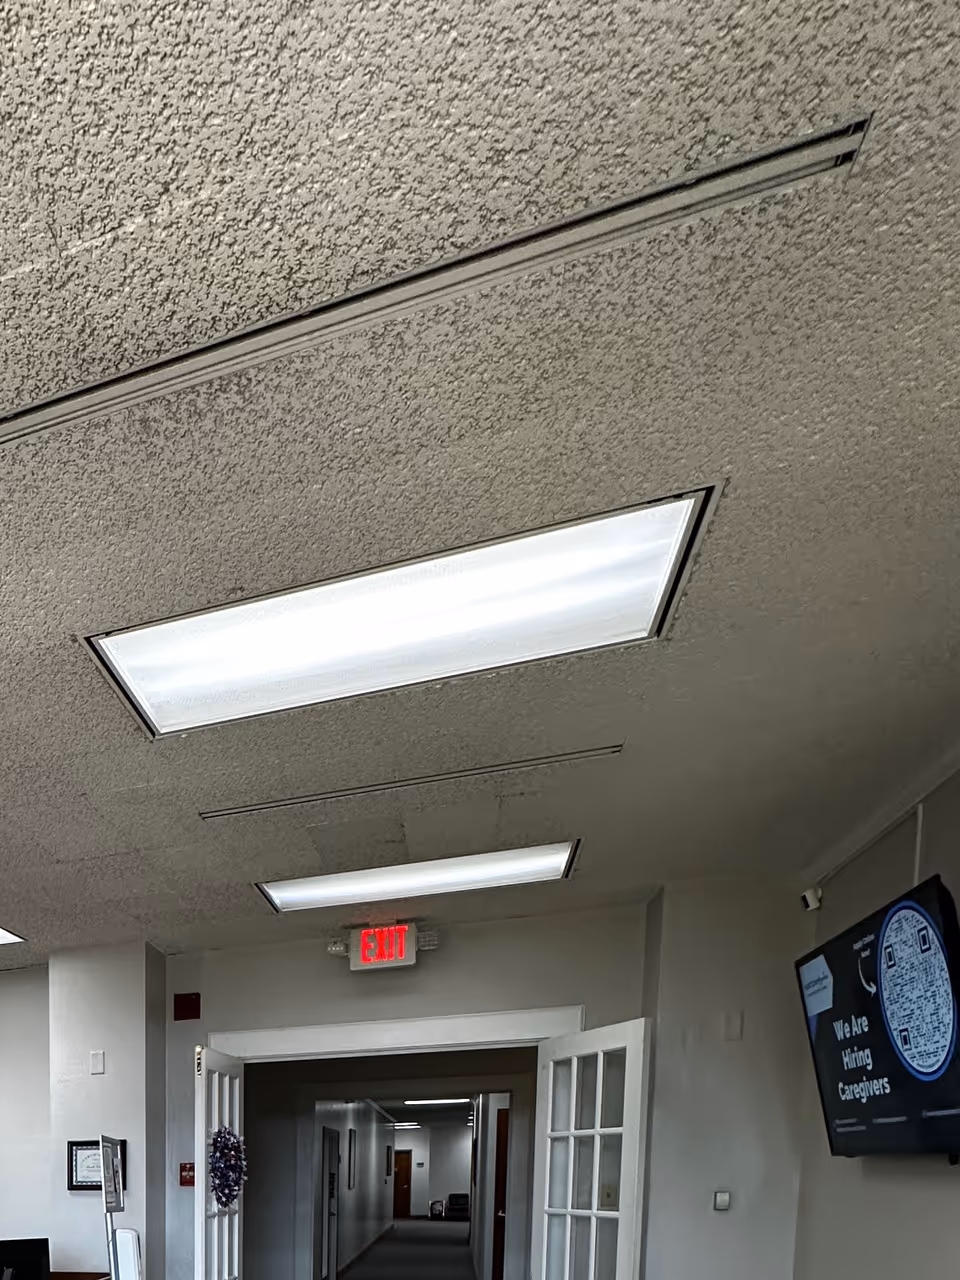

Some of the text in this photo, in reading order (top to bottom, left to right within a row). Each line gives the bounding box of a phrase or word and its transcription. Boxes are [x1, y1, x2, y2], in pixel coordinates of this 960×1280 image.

[361, 925, 408, 963] EXIT
[833, 1014, 868, 1041] We Are
[841, 1046, 872, 1070] Hiring
[838, 1075, 890, 1103] Caregivers
